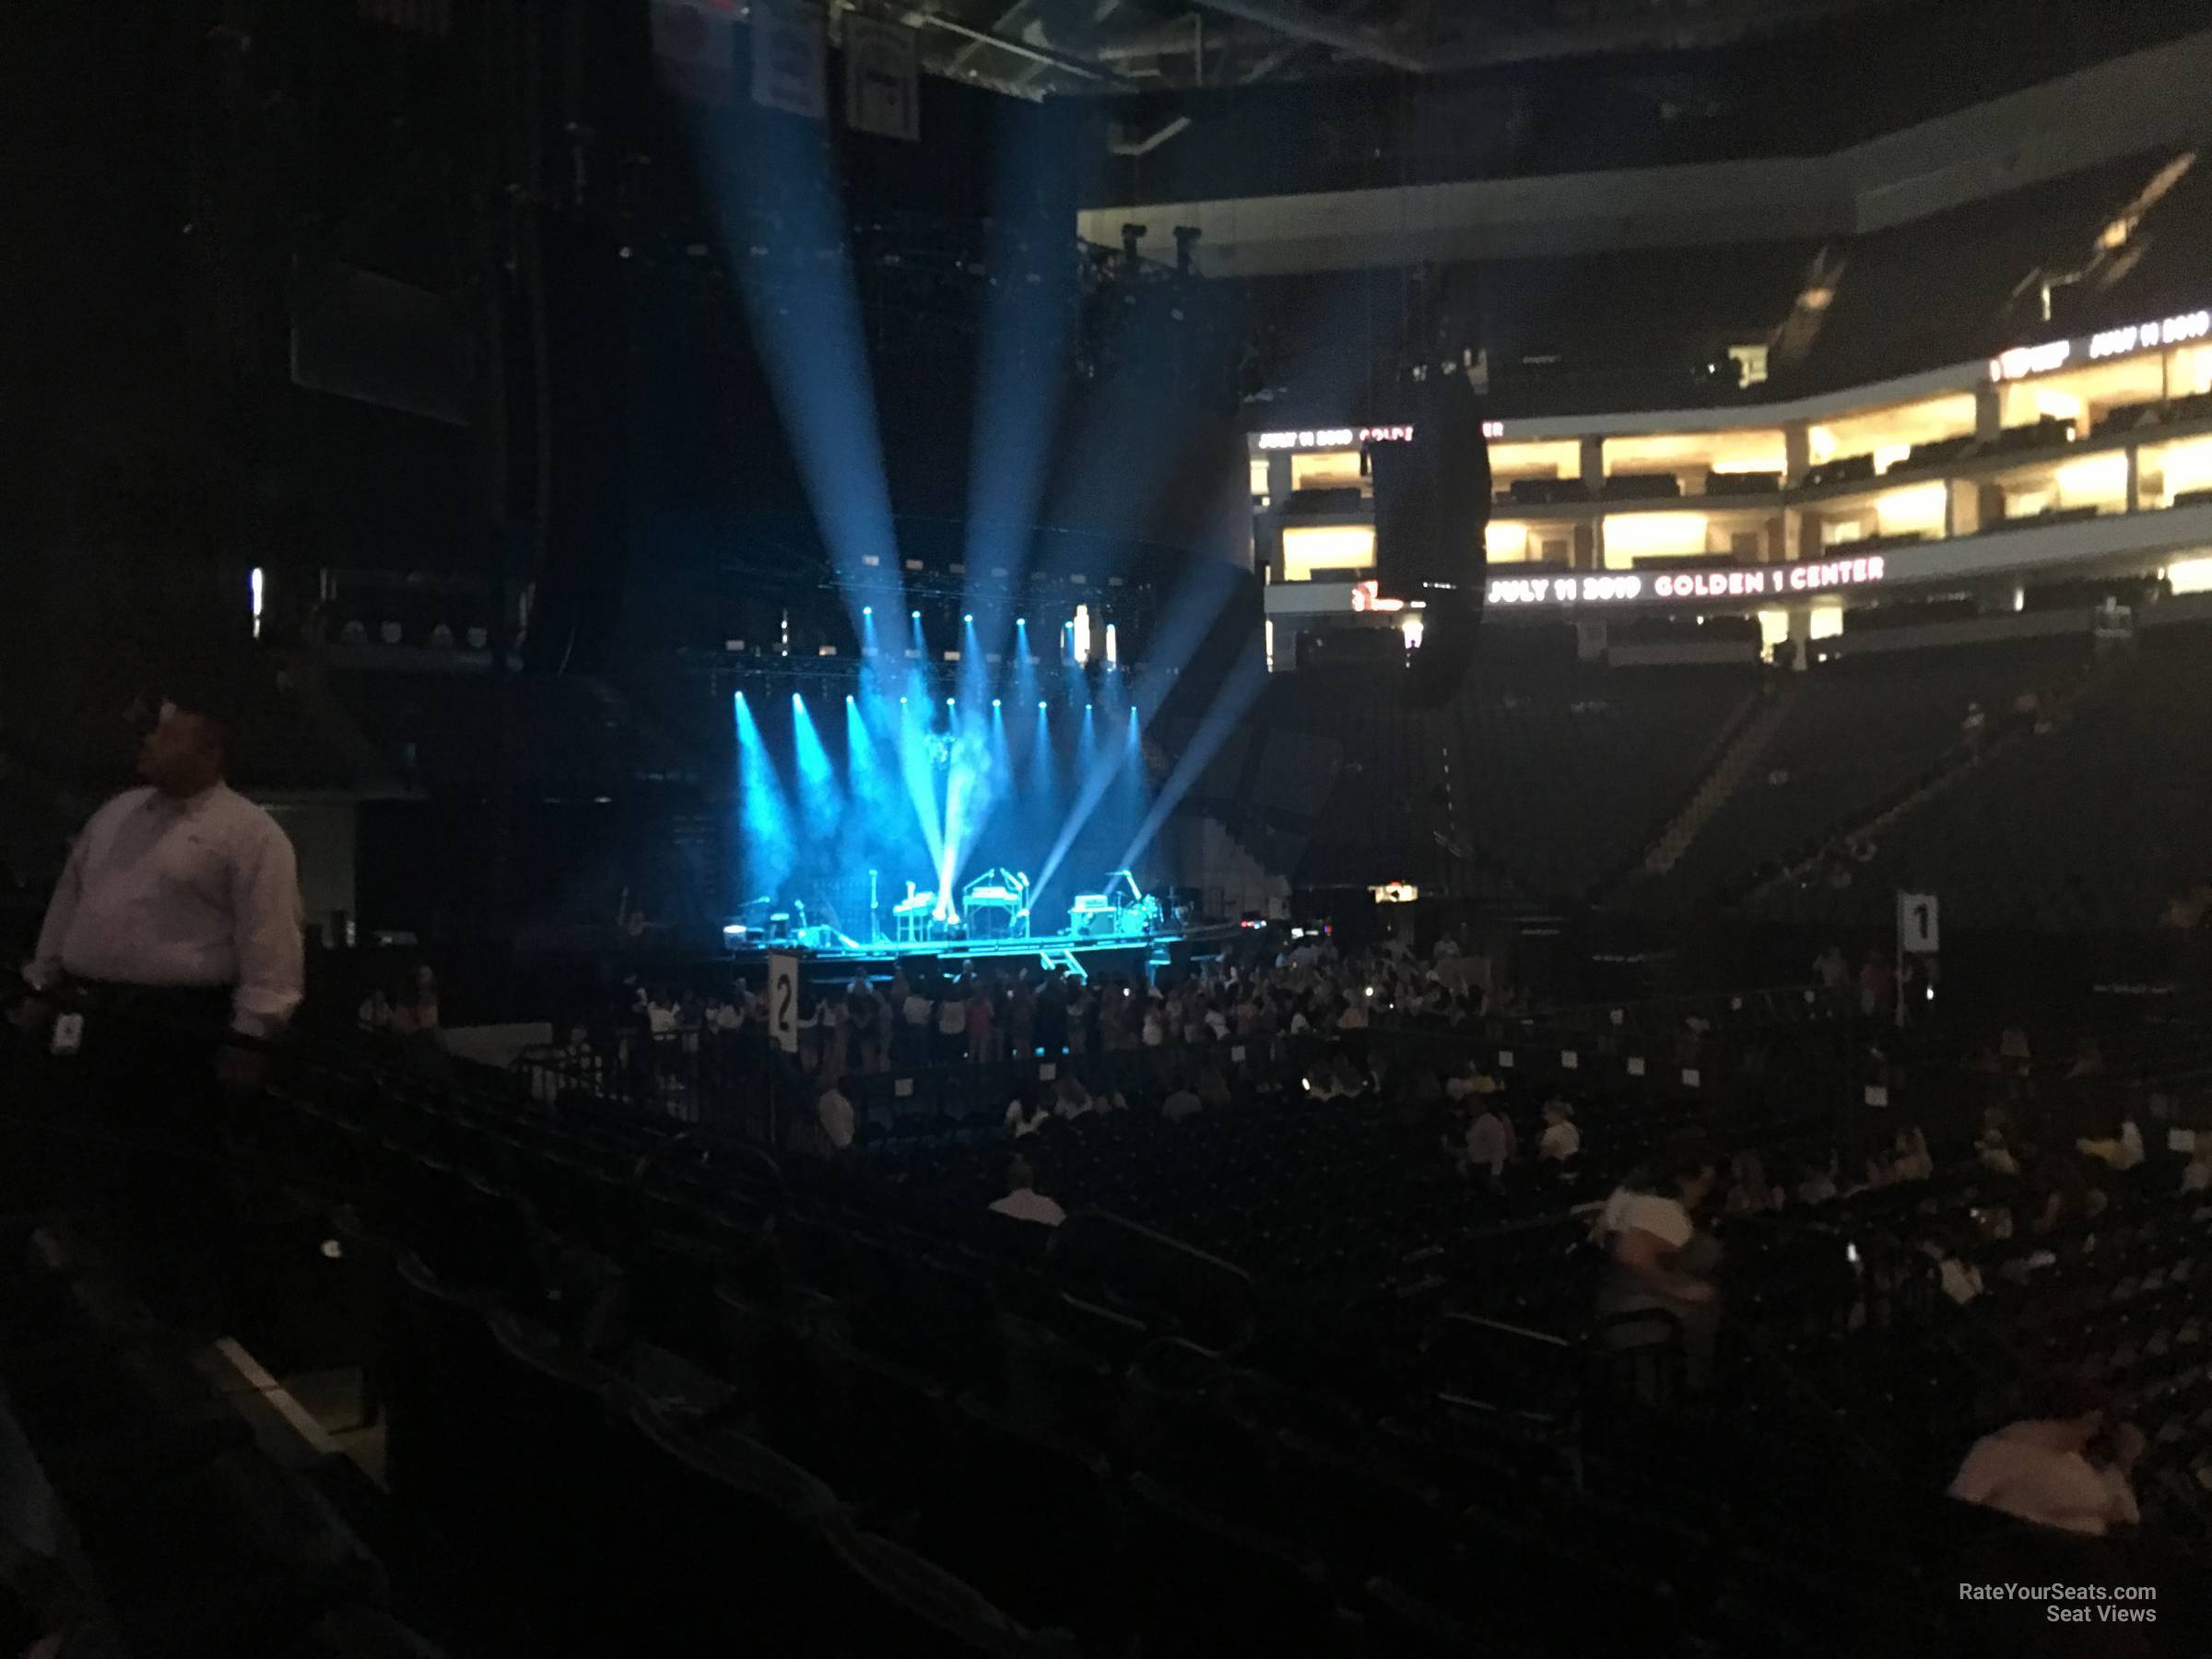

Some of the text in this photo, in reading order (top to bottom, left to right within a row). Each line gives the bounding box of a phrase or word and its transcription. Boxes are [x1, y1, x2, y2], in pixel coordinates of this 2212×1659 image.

[1488, 557, 1884, 603] JULY 11 2019 GOLDEN 1 CENTER
[1912, 903, 1928, 939] 1
[777, 973, 791, 1031] 2
